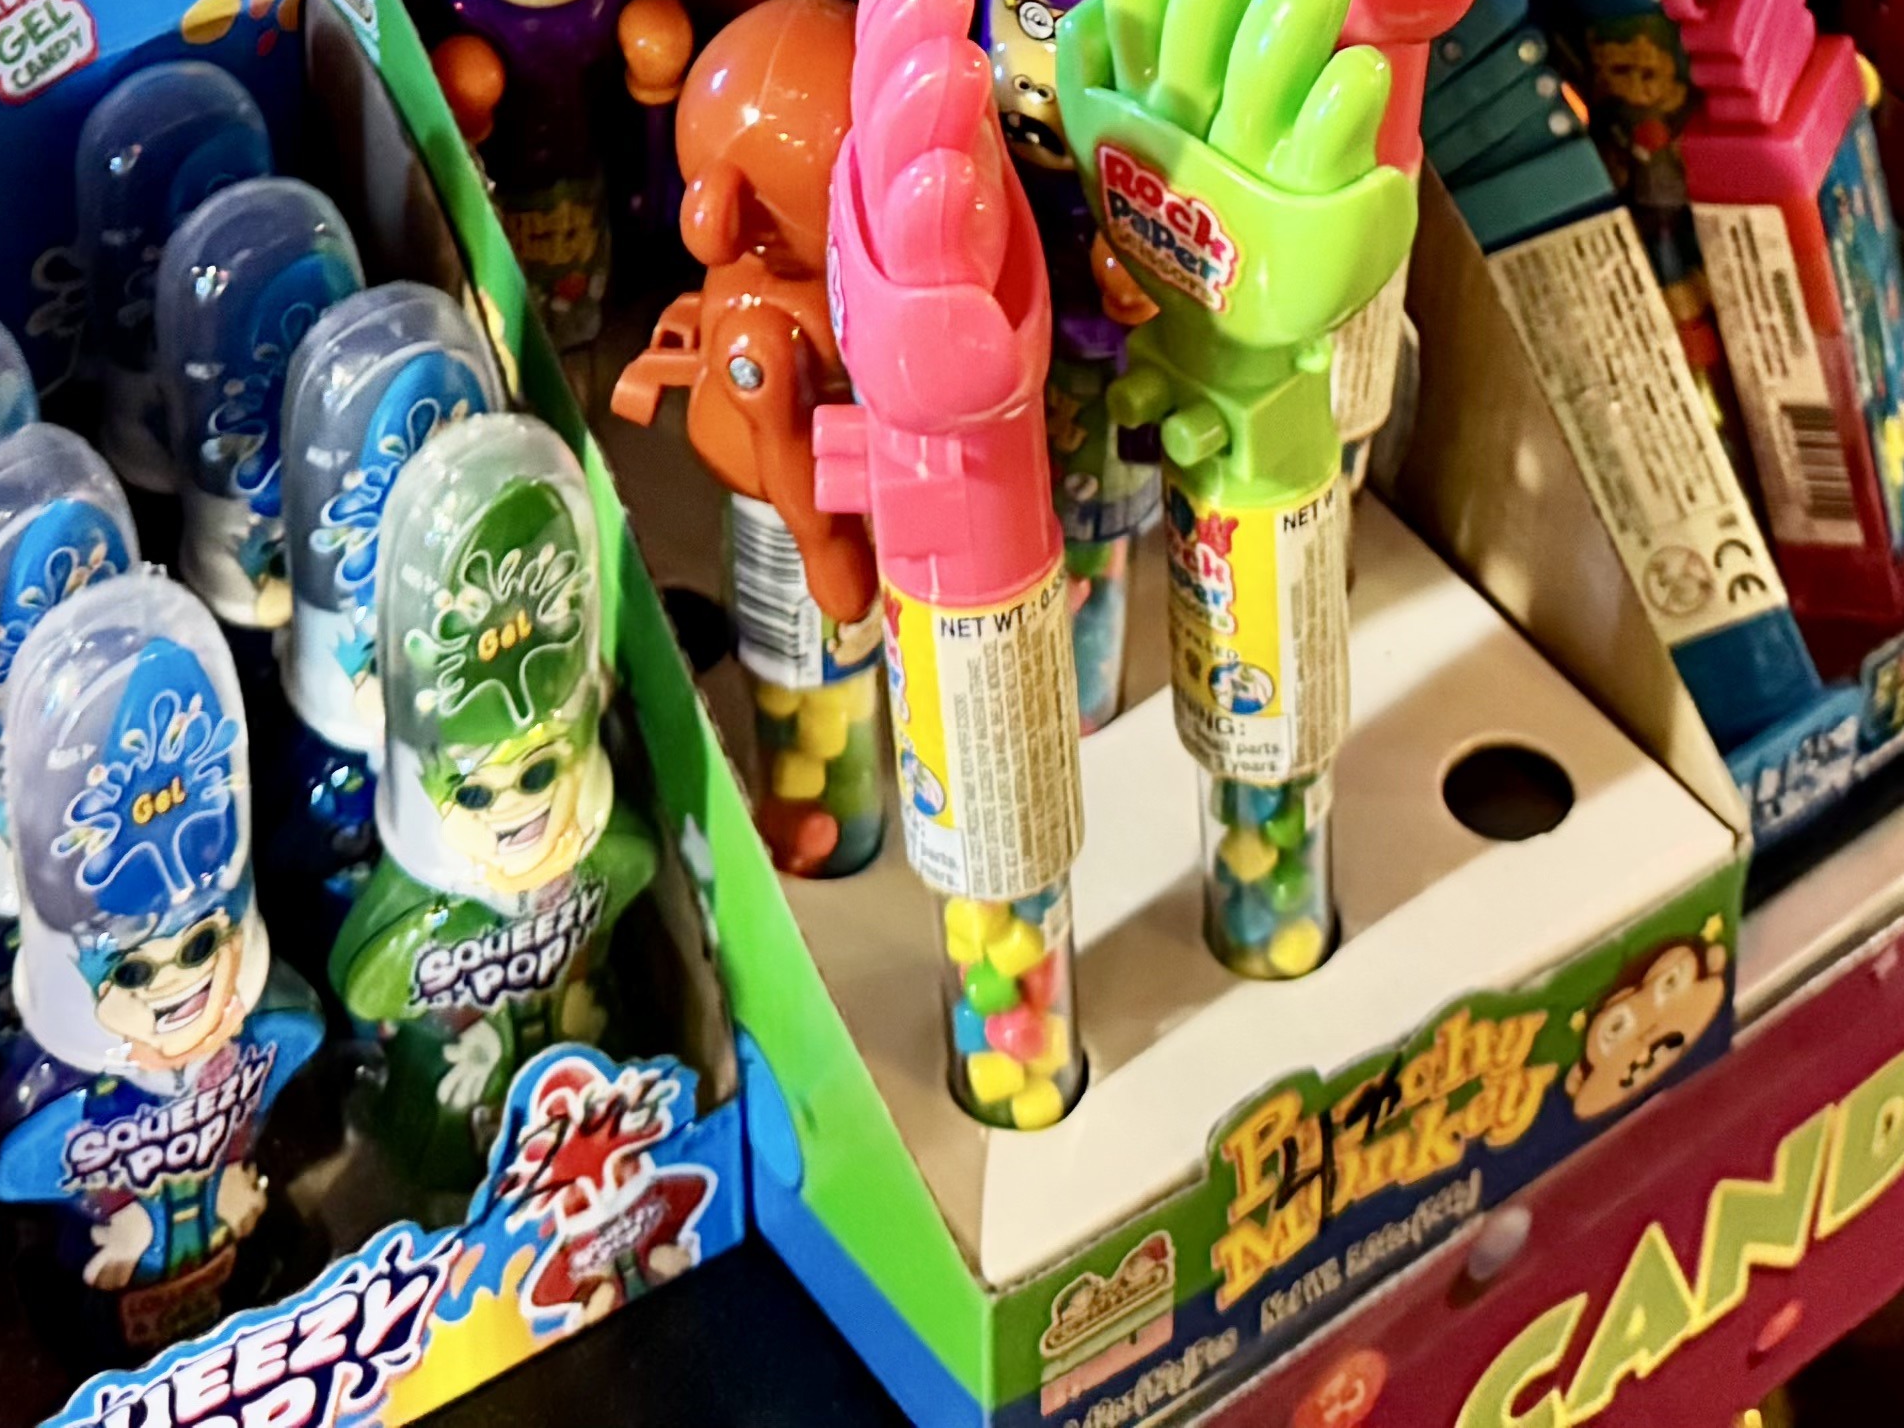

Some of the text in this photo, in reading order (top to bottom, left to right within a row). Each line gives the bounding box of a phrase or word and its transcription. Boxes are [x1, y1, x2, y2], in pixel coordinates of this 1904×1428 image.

[10, 26, 86, 93] CANDY
[1103, 151, 1227, 263] Rock
[1282, 503, 1320, 534] NET
[940, 615, 986, 639] NET
[418, 884, 608, 997] SQUEEZY
[471, 934, 568, 1007] POP
[66, 1062, 268, 1174] SQUEEZY
[127, 1121, 227, 1189] POP
[1210, 1062, 1559, 1312] Mnkey
[101, 1271, 434, 1428] UEEZY
